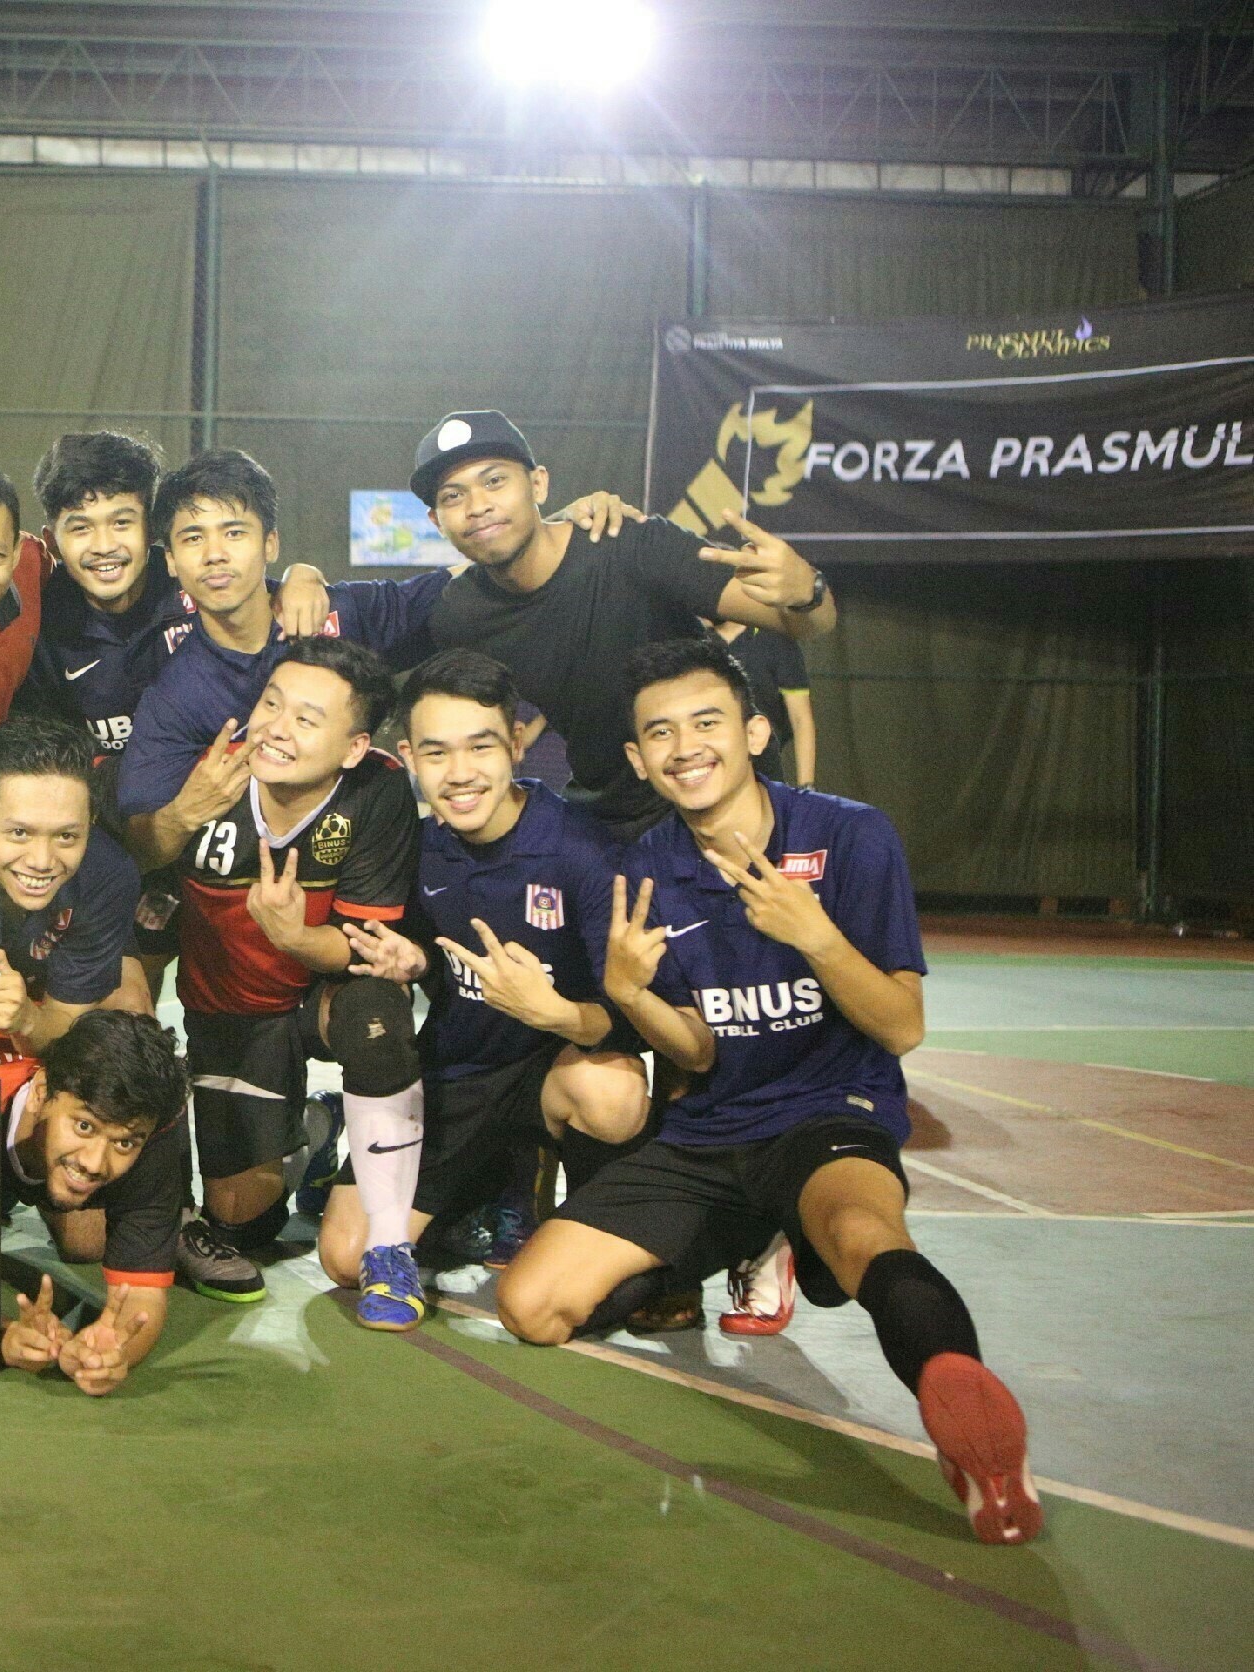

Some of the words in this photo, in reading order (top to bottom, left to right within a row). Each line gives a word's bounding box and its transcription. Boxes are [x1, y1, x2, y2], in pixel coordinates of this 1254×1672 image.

[804, 439, 970, 482] FORZA
[989, 420, 1254, 479] PRASMUL
[195, 819, 238, 876] 13
[769, 1012, 824, 1032] CLUB
